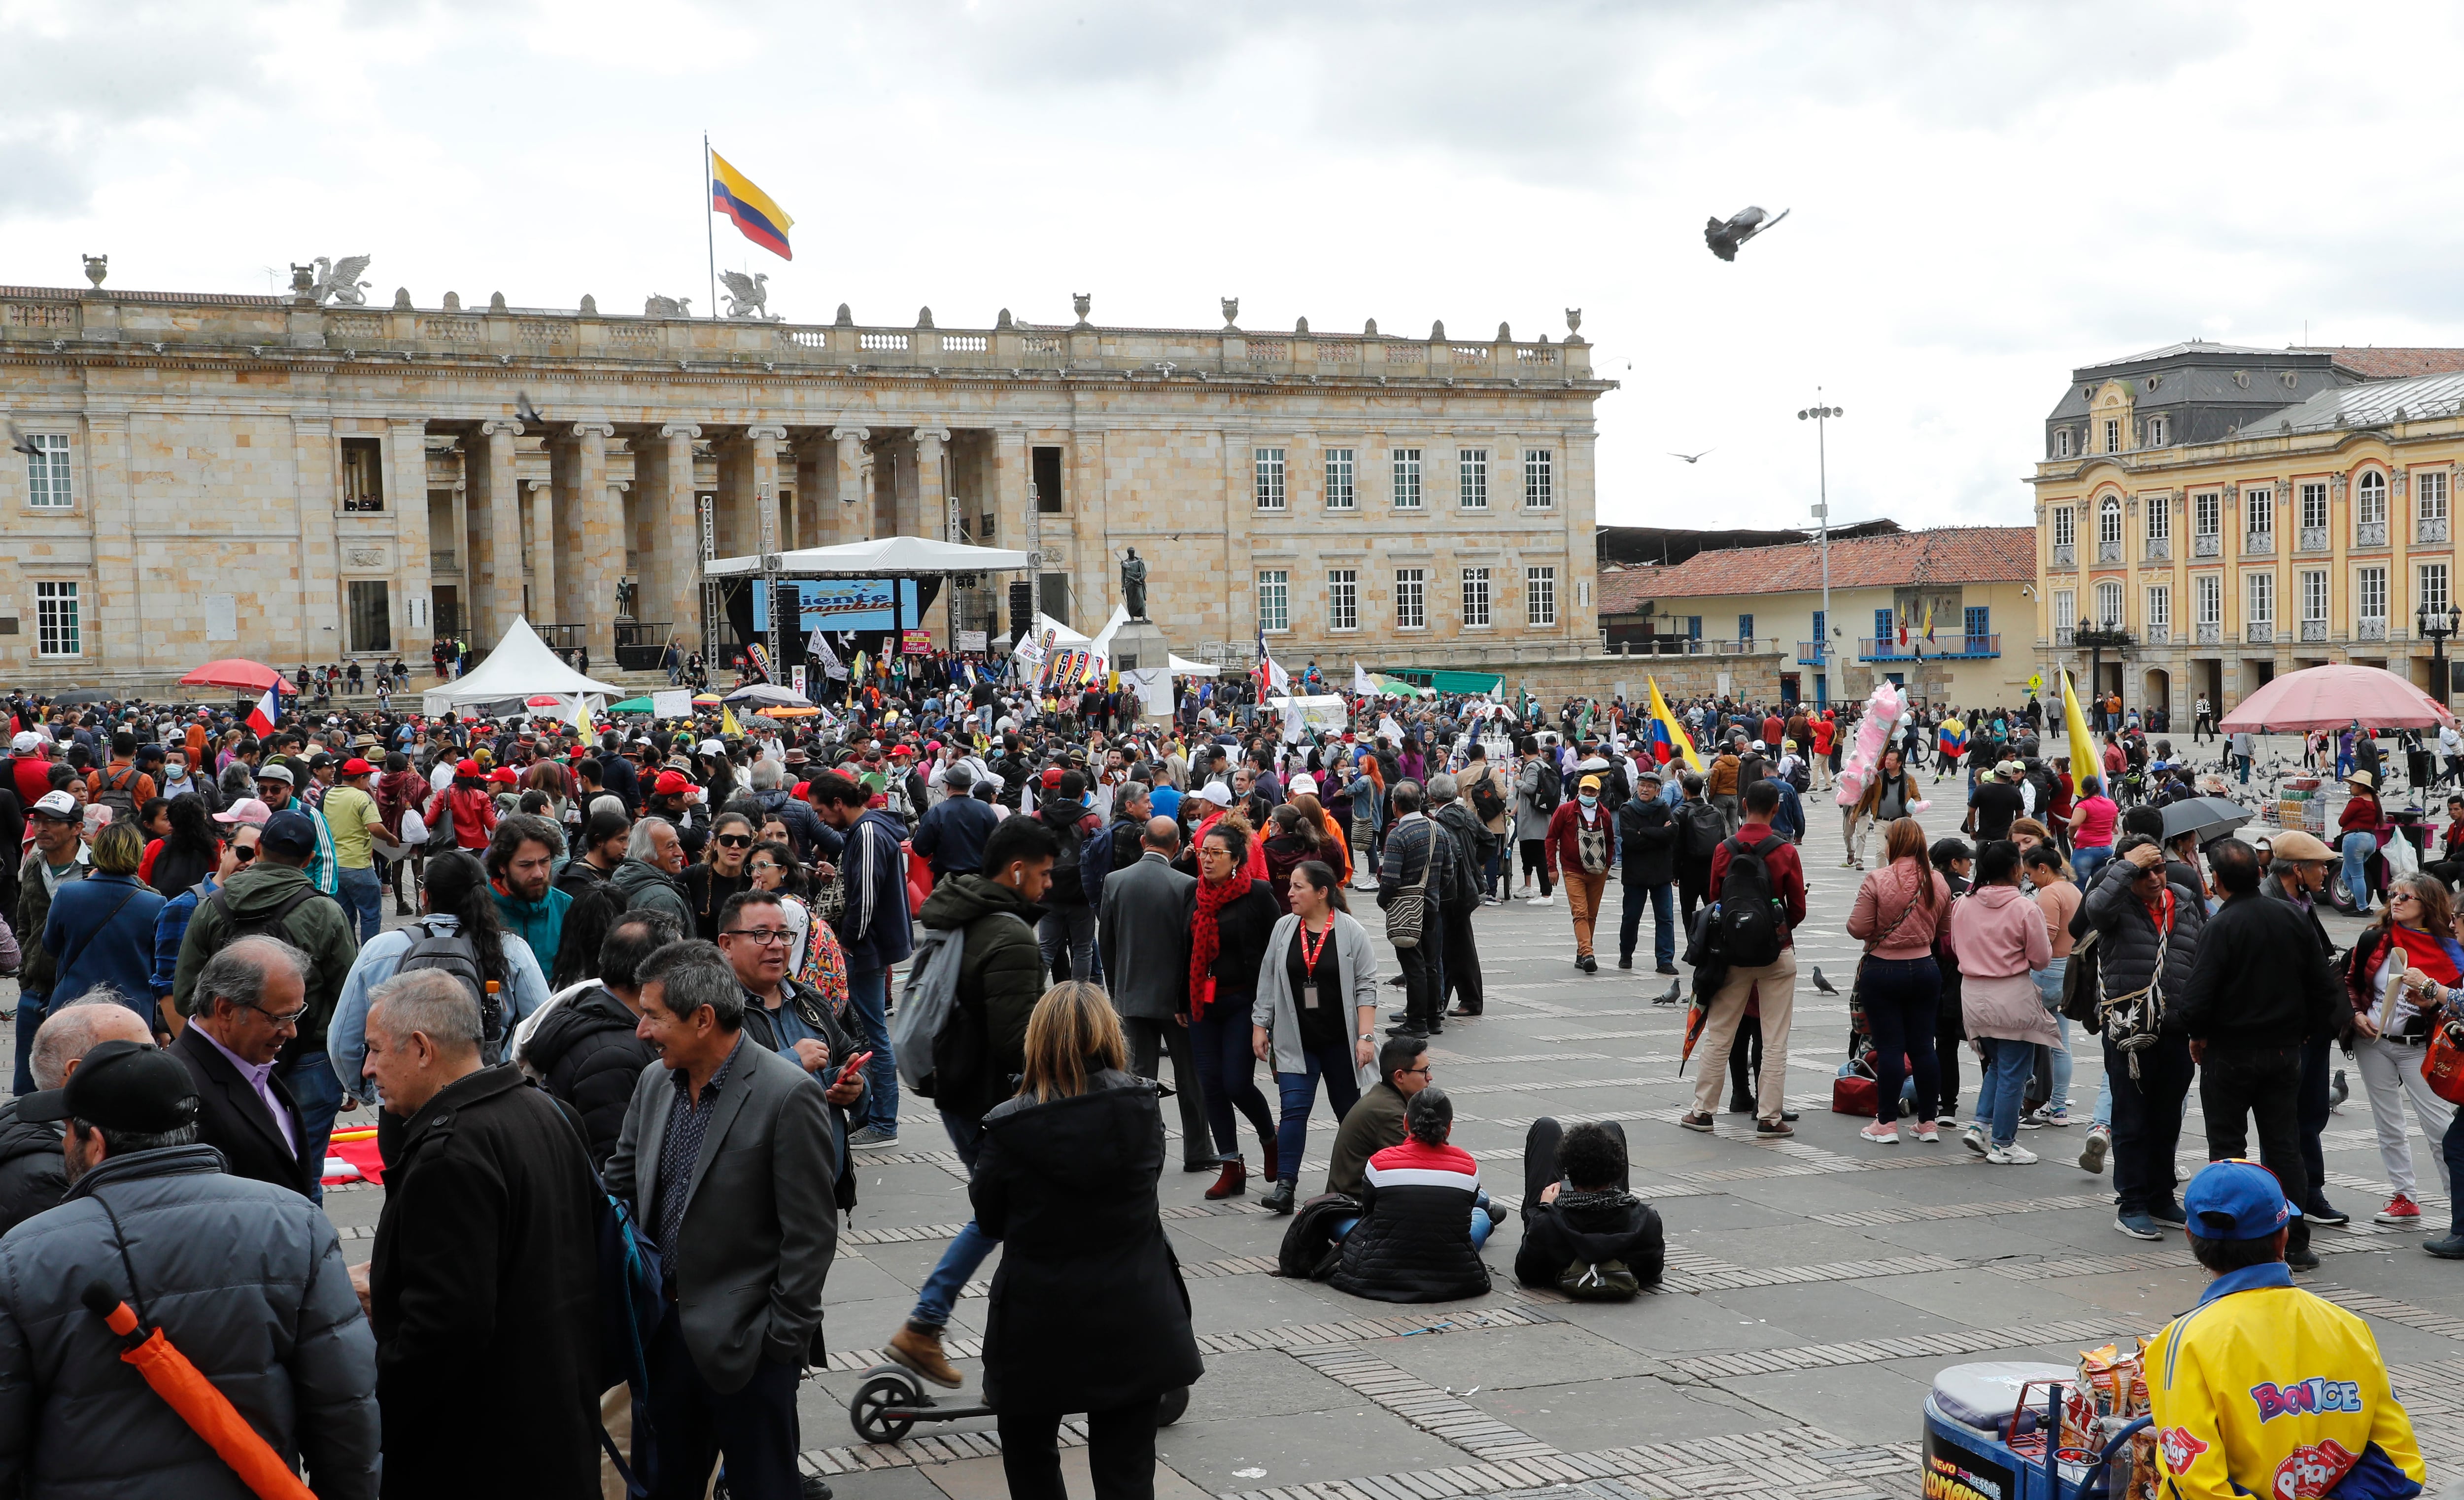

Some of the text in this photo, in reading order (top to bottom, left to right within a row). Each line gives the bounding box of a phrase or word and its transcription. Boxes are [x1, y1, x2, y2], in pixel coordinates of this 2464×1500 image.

[799, 593, 889, 605] iente
[752, 646, 770, 673] CUT
[1056, 655, 1069, 684] CUT
[1930, 1454, 1956, 1474] NUEVO
